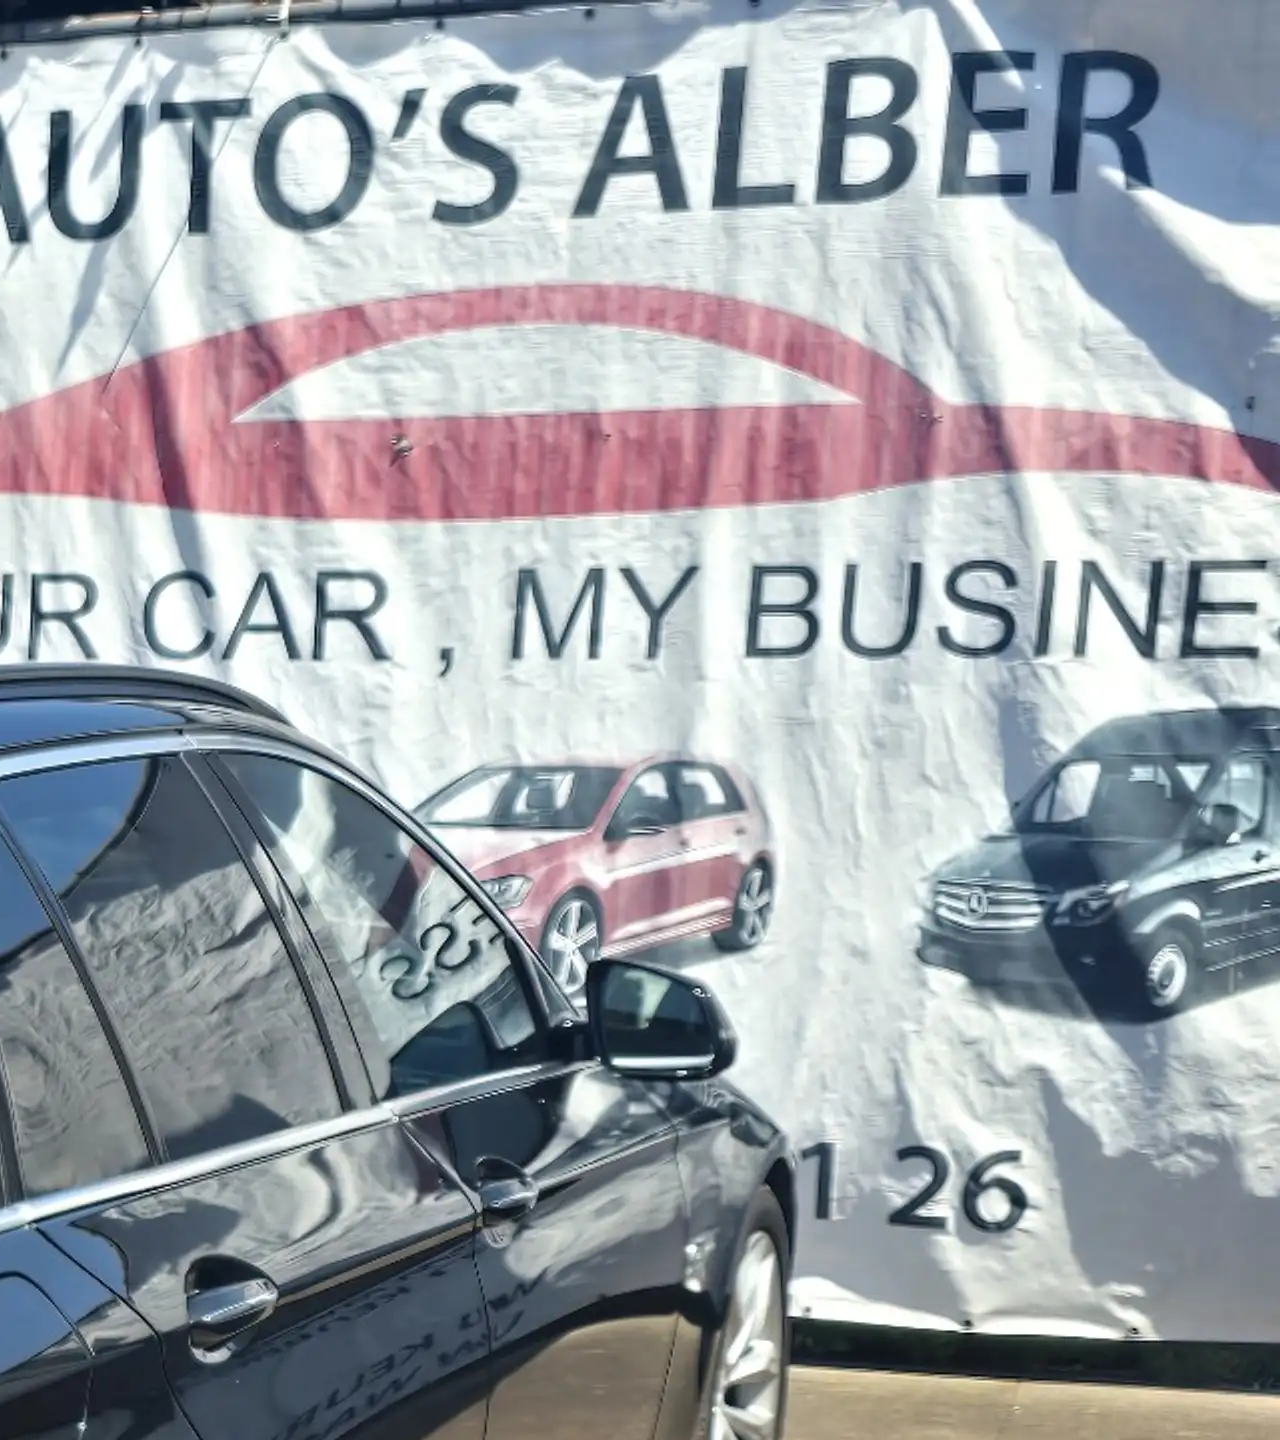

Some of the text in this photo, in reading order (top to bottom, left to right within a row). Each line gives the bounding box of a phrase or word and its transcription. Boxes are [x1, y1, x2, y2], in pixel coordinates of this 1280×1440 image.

[572, 50, 1164, 220] ALBER
[143, 569, 390, 661] CAR
[509, 562, 700, 661] MY
[744, 558, 1280, 661] BUSINE
[887, 1145, 1029, 1234] 26
